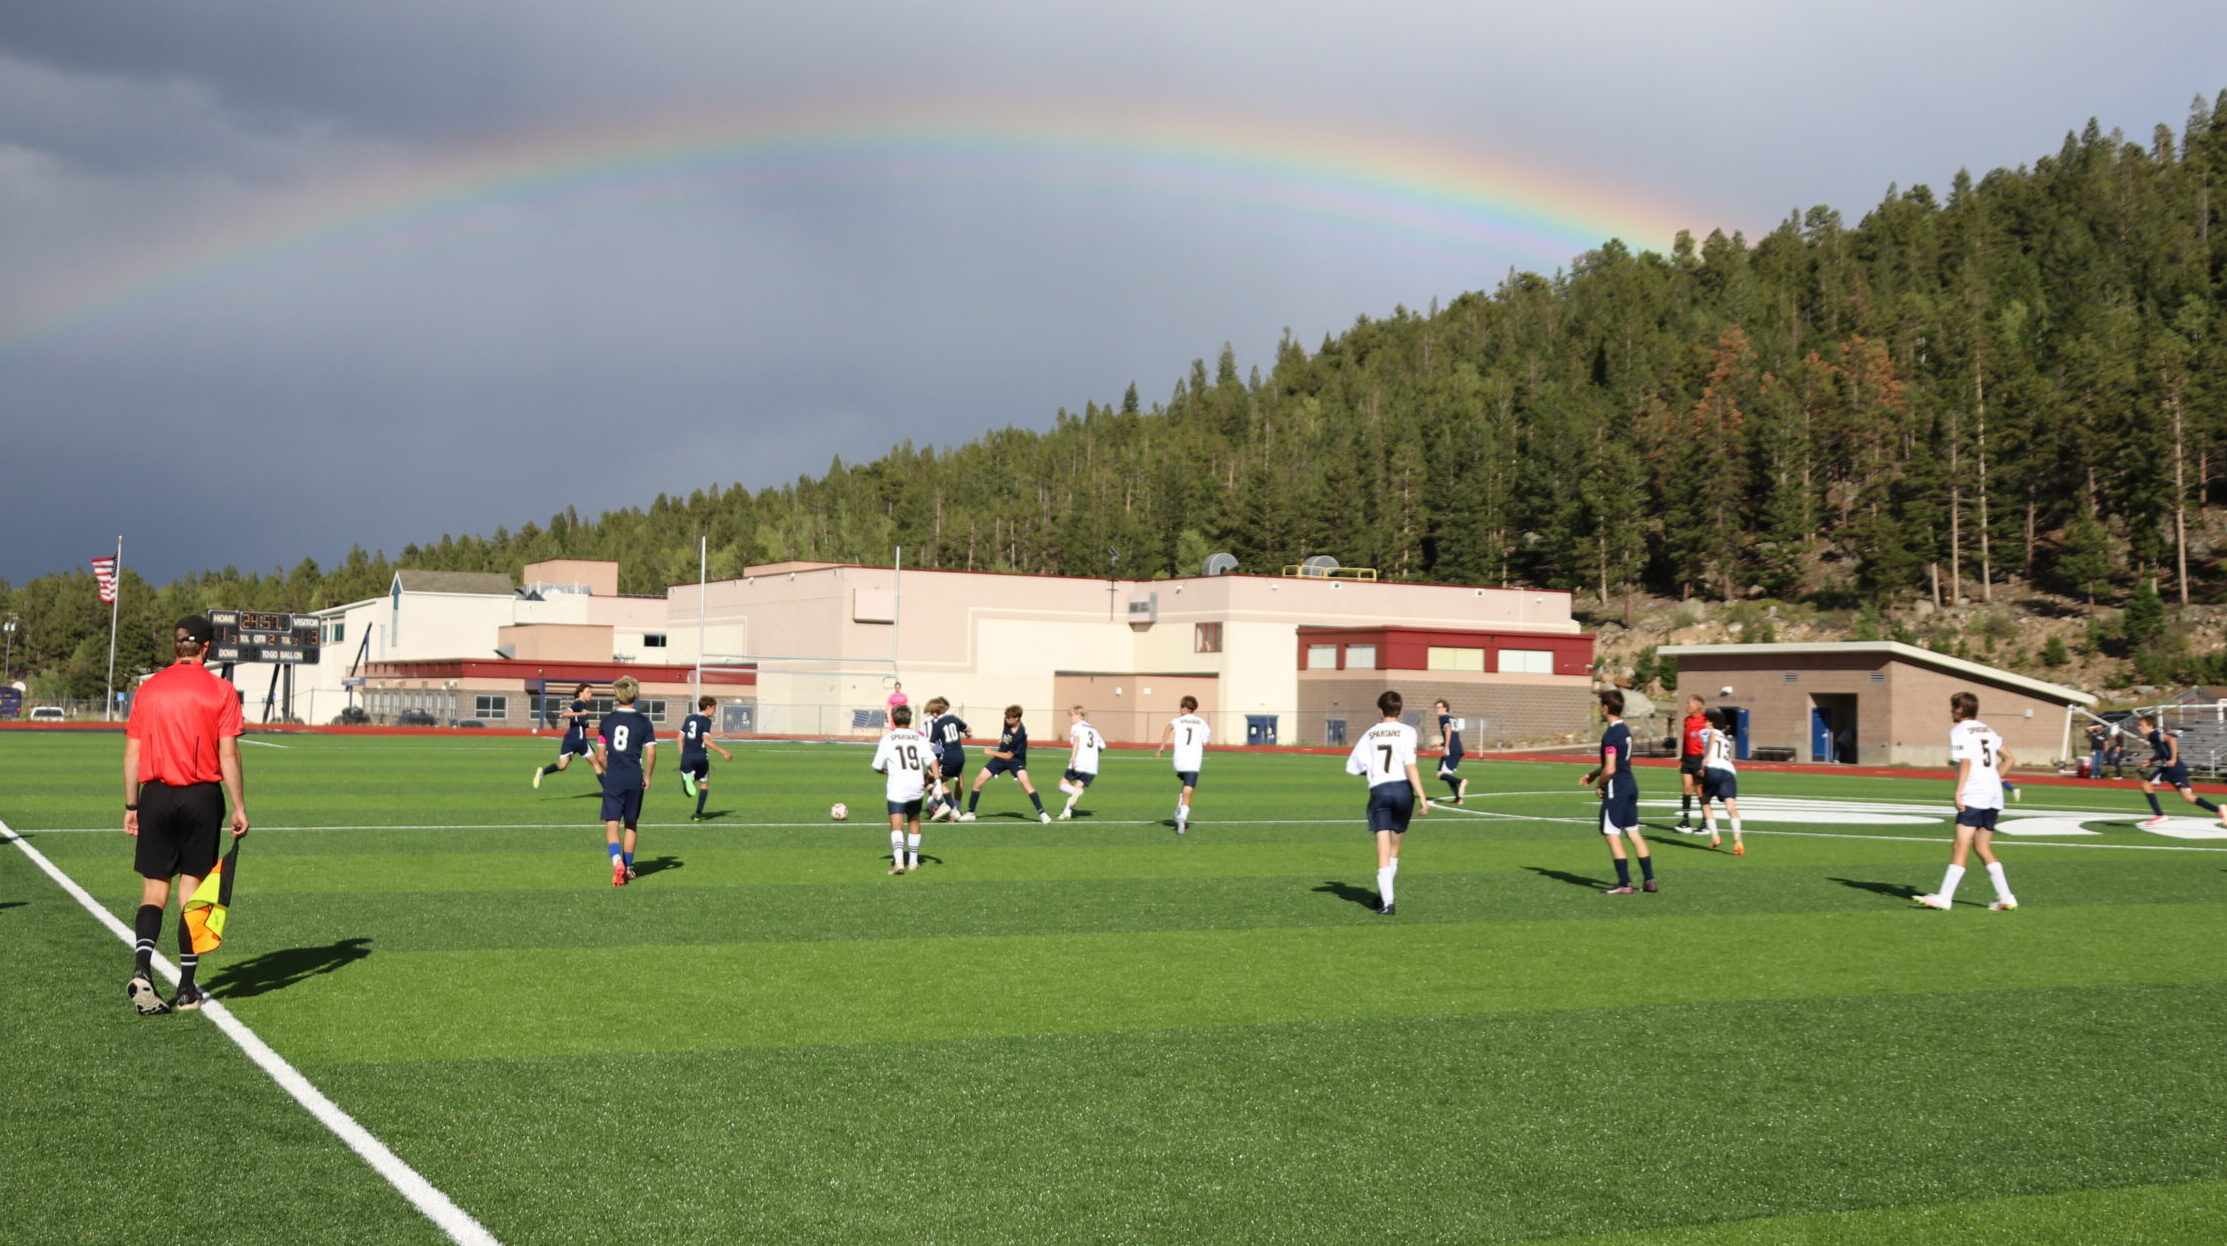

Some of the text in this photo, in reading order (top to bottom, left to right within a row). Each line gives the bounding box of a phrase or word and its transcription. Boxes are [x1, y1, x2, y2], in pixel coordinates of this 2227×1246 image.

[213, 614, 236, 624] HOME
[293, 618, 319, 628] VISITOR
[219, 649, 238, 658] DOWN
[613, 725, 629, 751] 8
[688, 720, 698, 739] 3
[942, 722, 959, 743] 10
[1086, 731, 1094, 748] 3
[895, 745, 920, 771] 19
[1377, 744, 1392, 773] 7
[1980, 739, 1991, 768] 5
